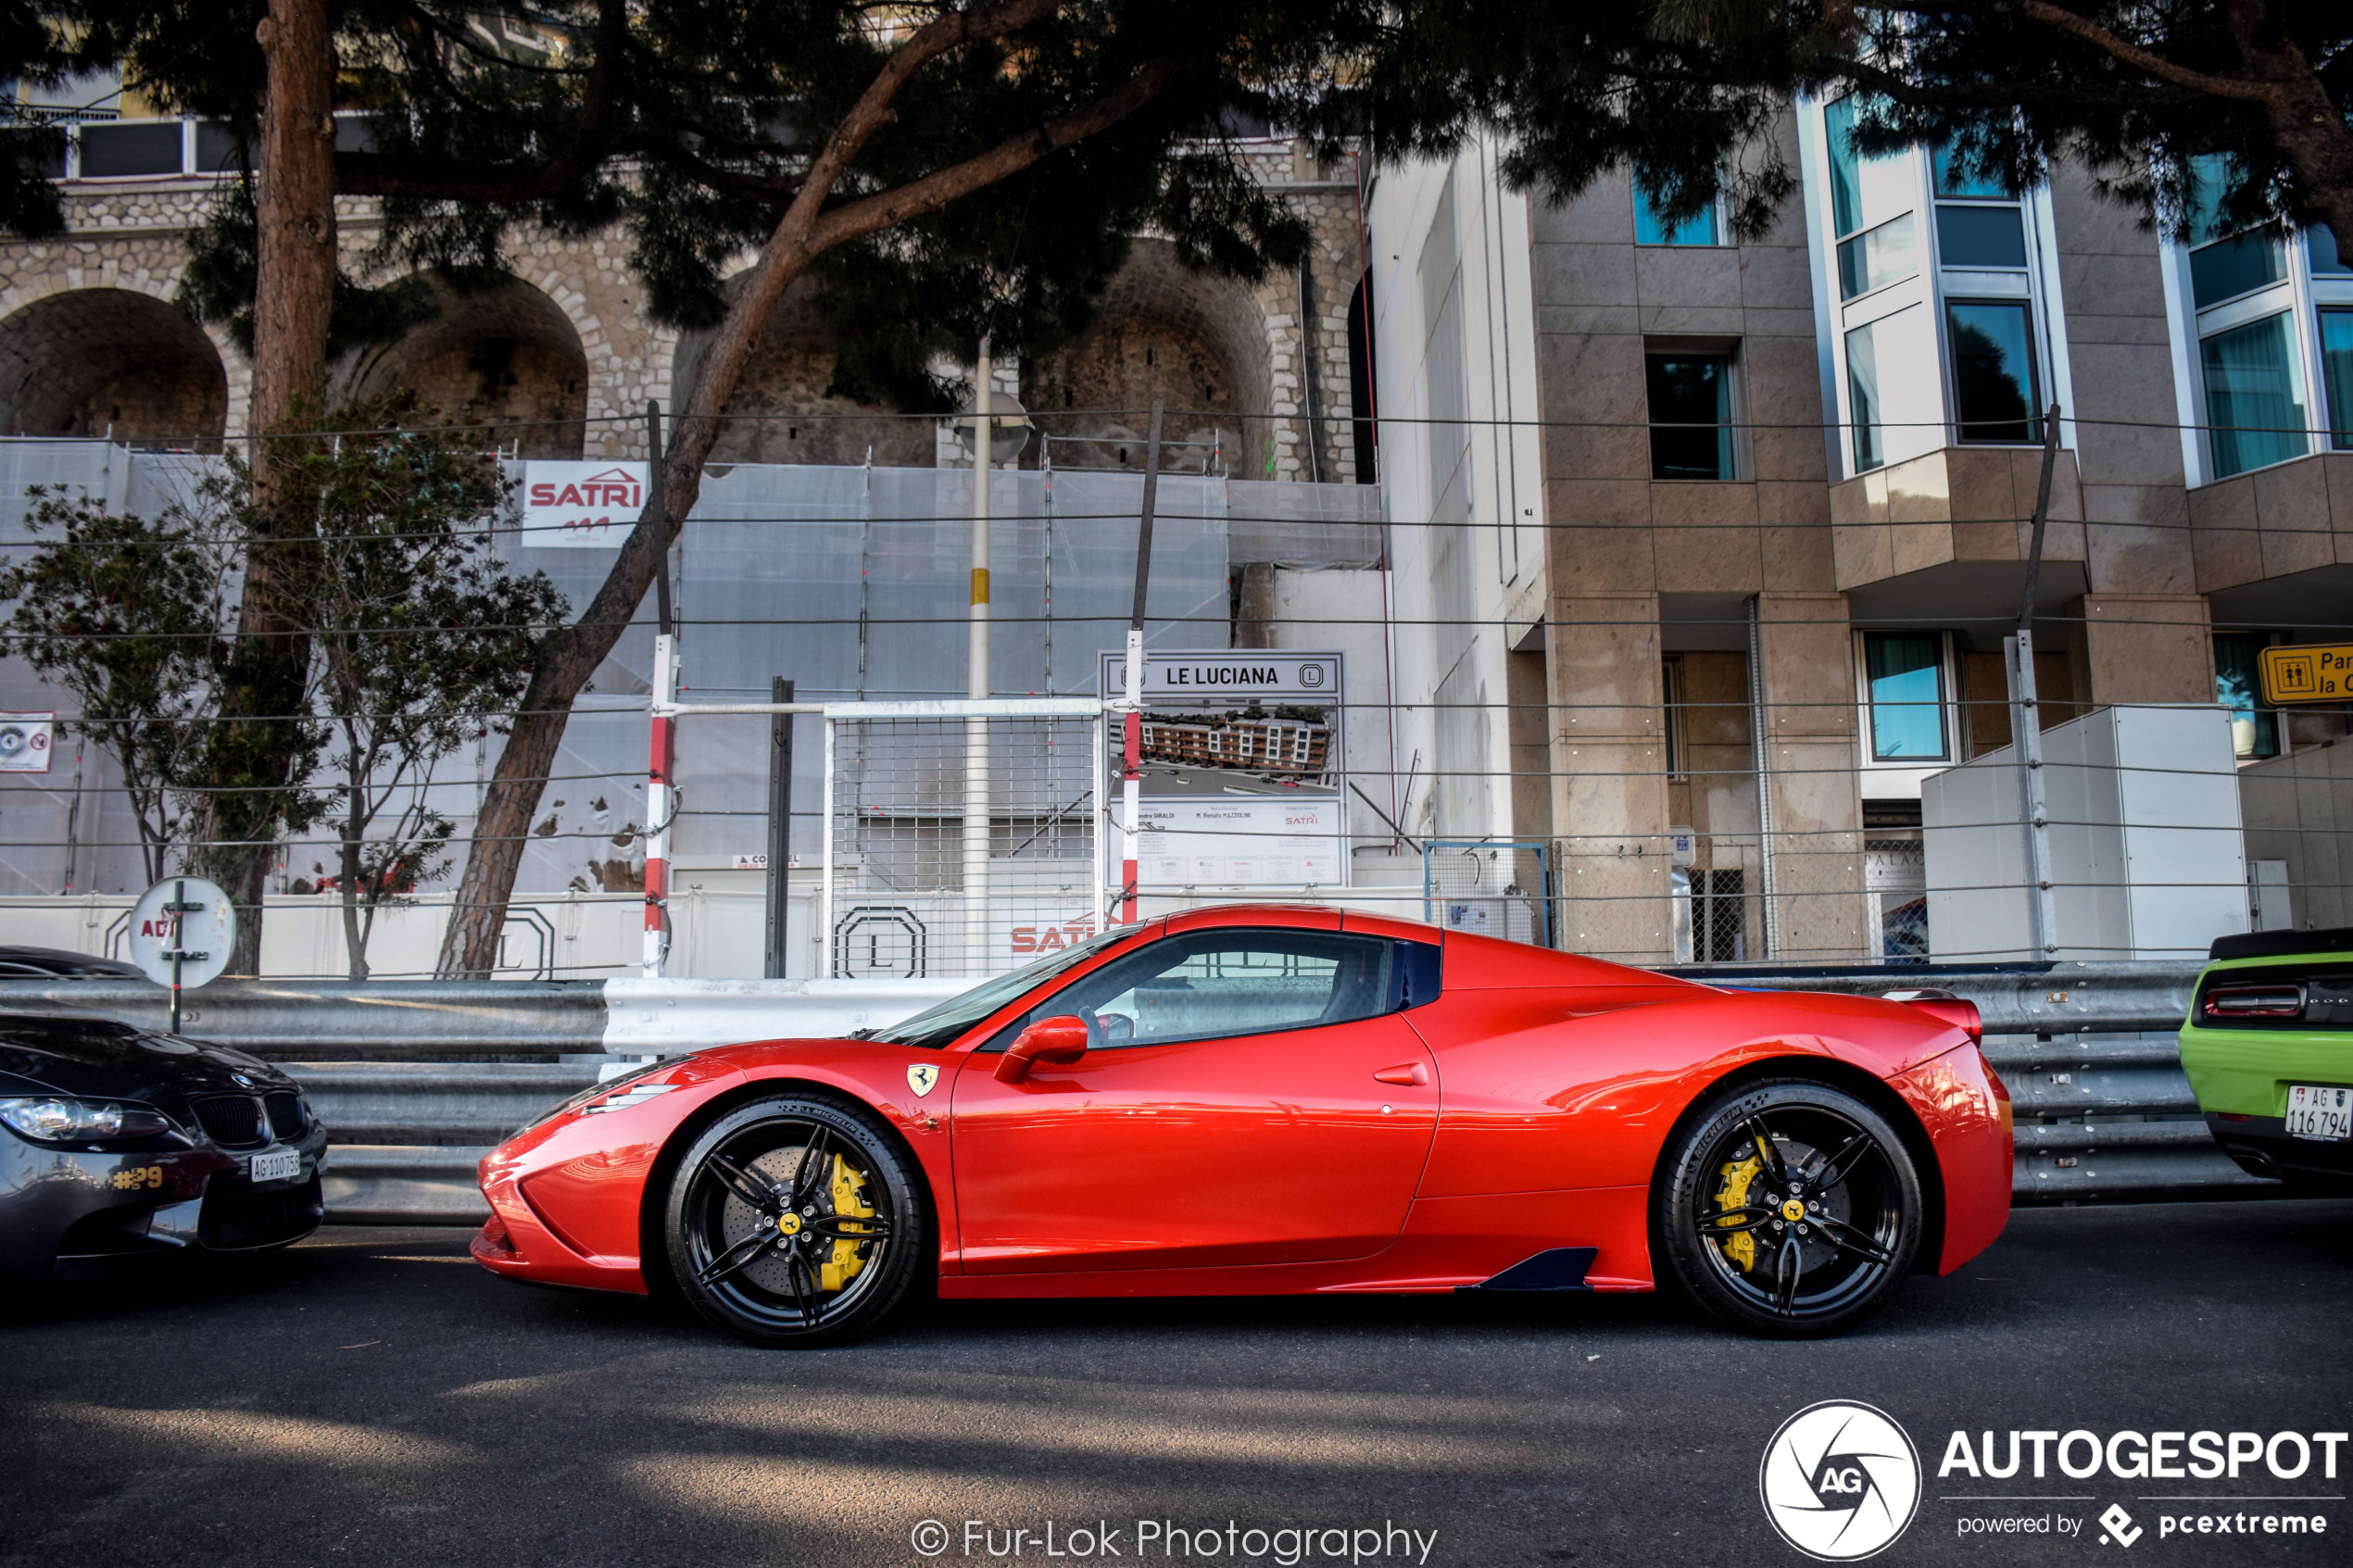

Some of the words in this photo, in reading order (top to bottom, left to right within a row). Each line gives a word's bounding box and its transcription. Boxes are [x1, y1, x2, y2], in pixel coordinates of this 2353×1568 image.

[530, 483, 641, 508] SATRI
[1166, 668, 1189, 684] LE
[1195, 668, 1278, 684] LUCIANA
[2320, 676, 2335, 694] la
[2311, 1088, 2327, 1108] AG
[812, 1109, 858, 1134] MICHELIN
[1693, 1106, 1742, 1159] MICHELIN
[2290, 1109, 2315, 1133] 116
[2321, 1111, 2347, 1136] 794
